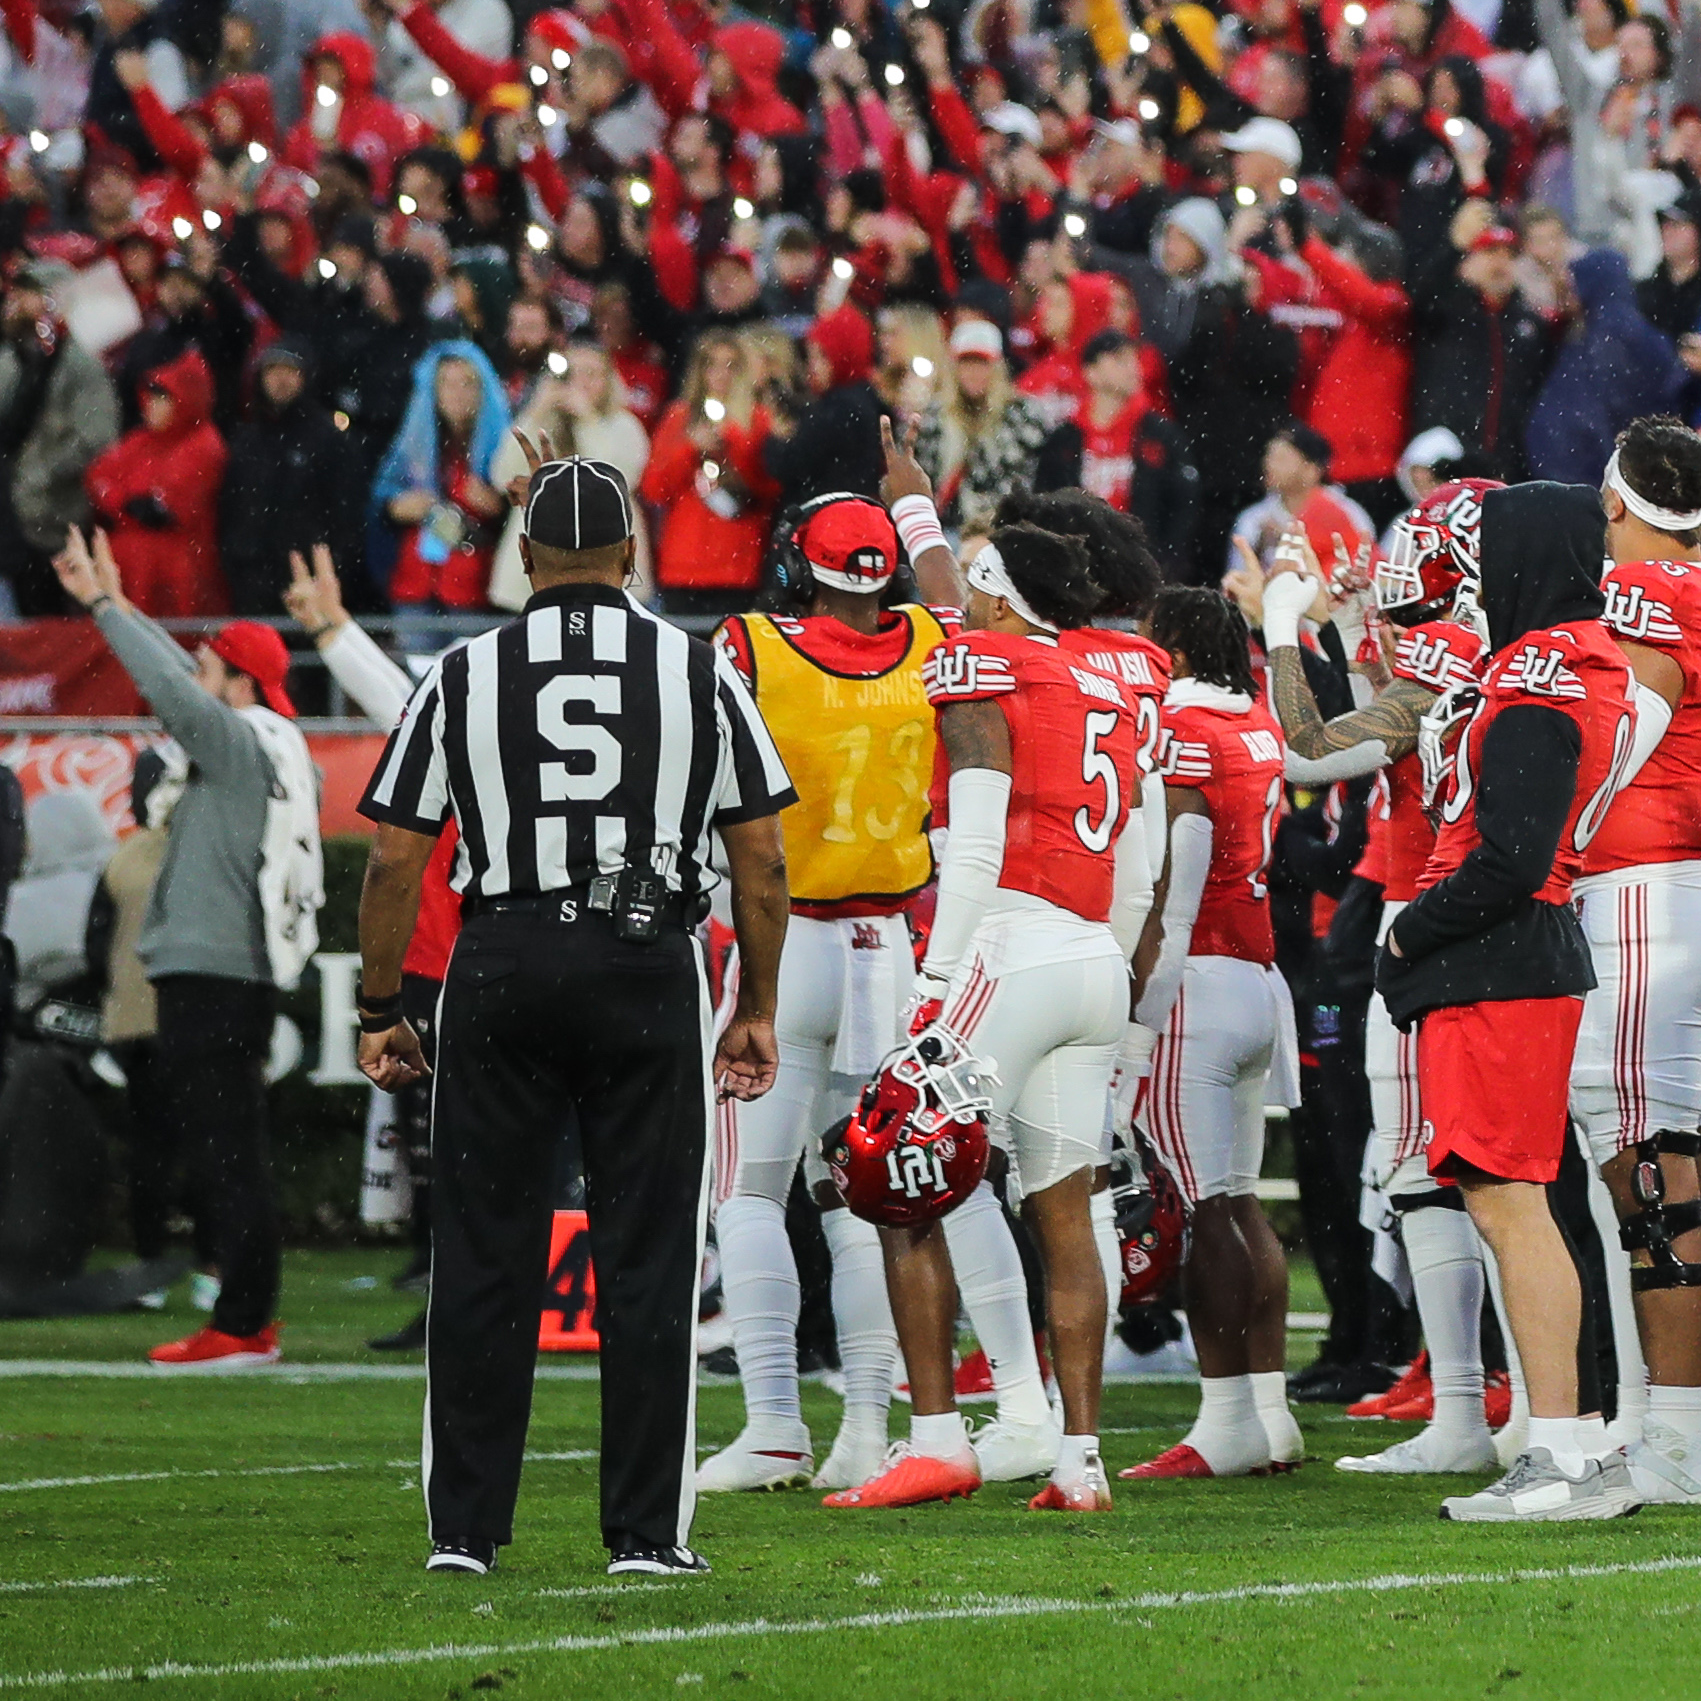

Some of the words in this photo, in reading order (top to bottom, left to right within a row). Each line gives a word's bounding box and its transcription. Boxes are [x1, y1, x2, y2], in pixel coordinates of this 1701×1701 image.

[569, 611, 586, 631] S
[536, 674, 622, 802] S
[822, 719, 928, 846] 13
[1074, 709, 1120, 853] 5
[560, 900, 578, 923] S
